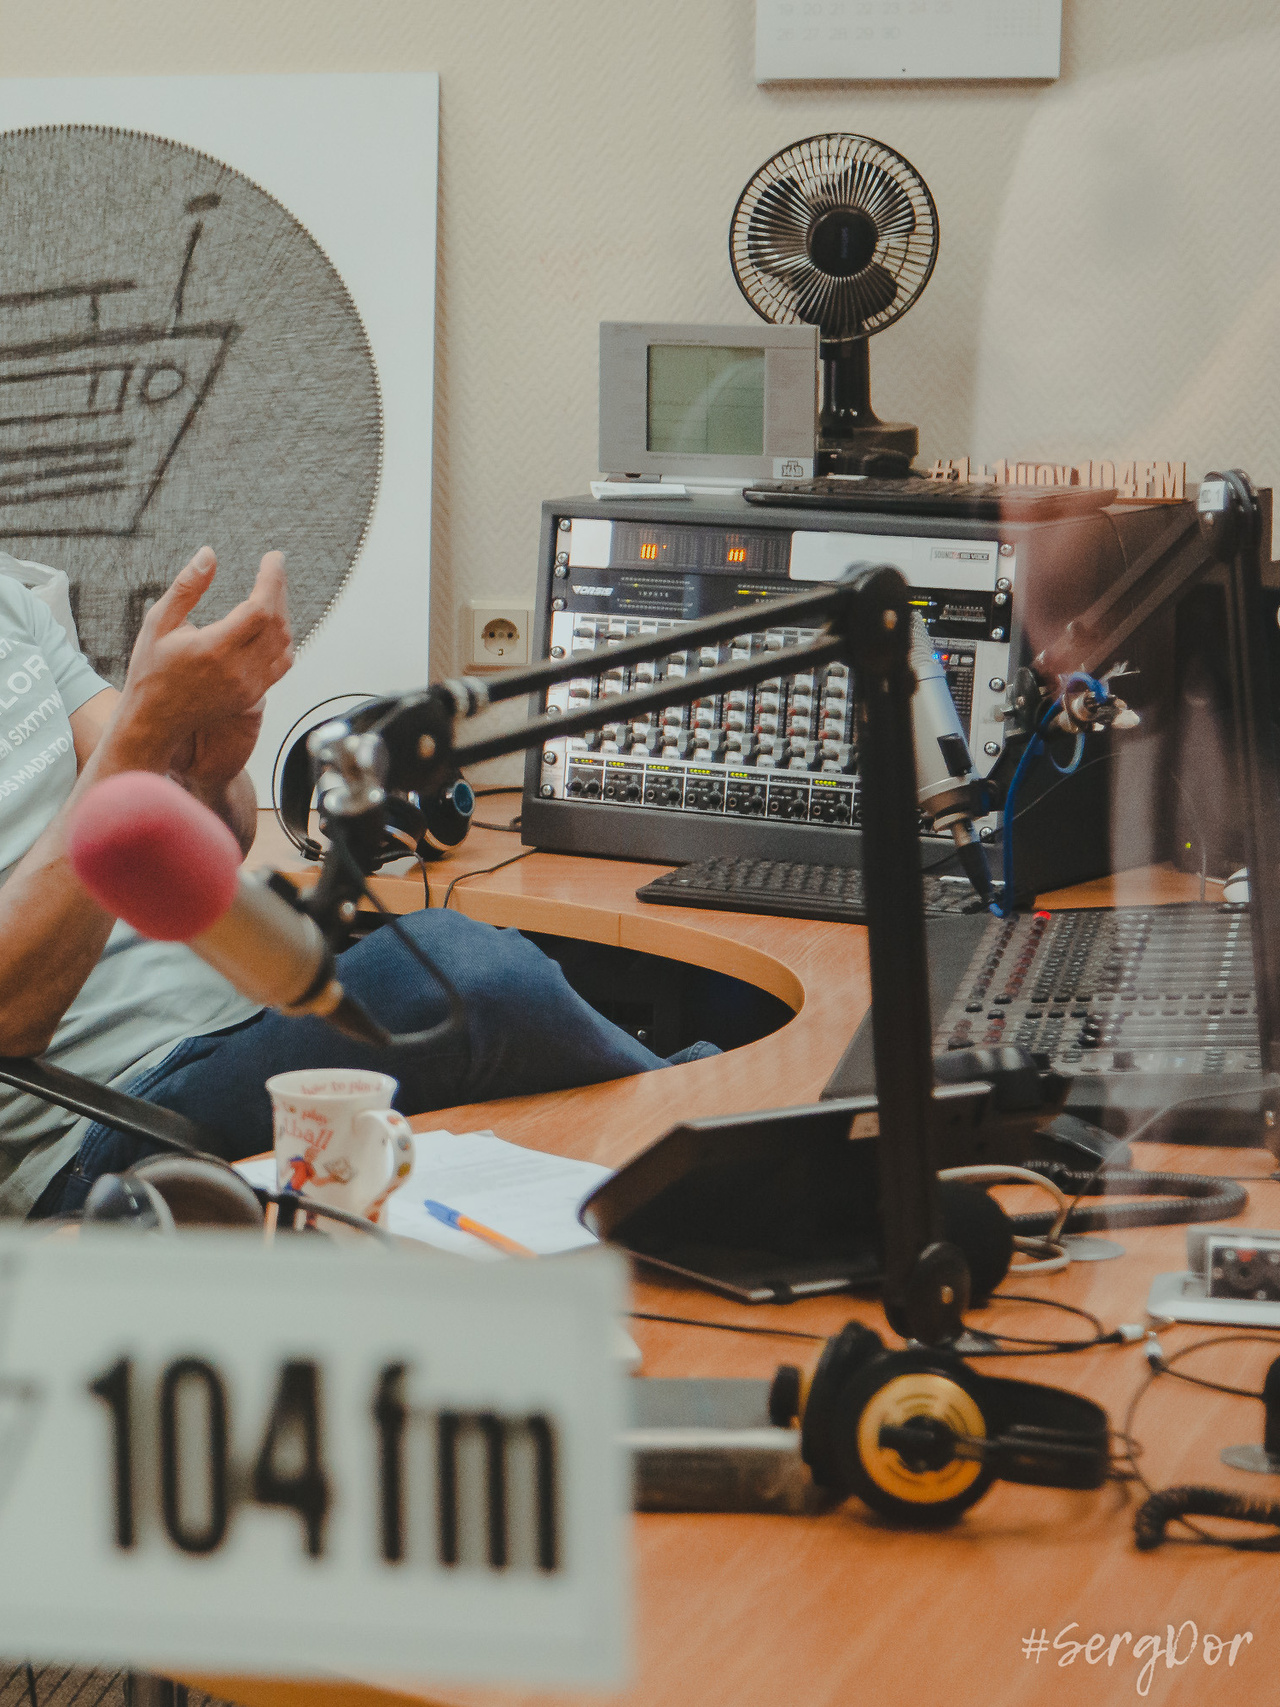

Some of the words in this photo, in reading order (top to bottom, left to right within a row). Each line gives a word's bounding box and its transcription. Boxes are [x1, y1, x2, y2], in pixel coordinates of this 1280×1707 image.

[776, 27, 795, 41] 26
[802, 27, 820, 41] 27
[828, 27, 848, 41] 28
[855, 26, 875, 41] 29
[881, 26, 901, 40] 30
[11, 750, 56, 785] MADE
[47, 736, 69, 757] TO
